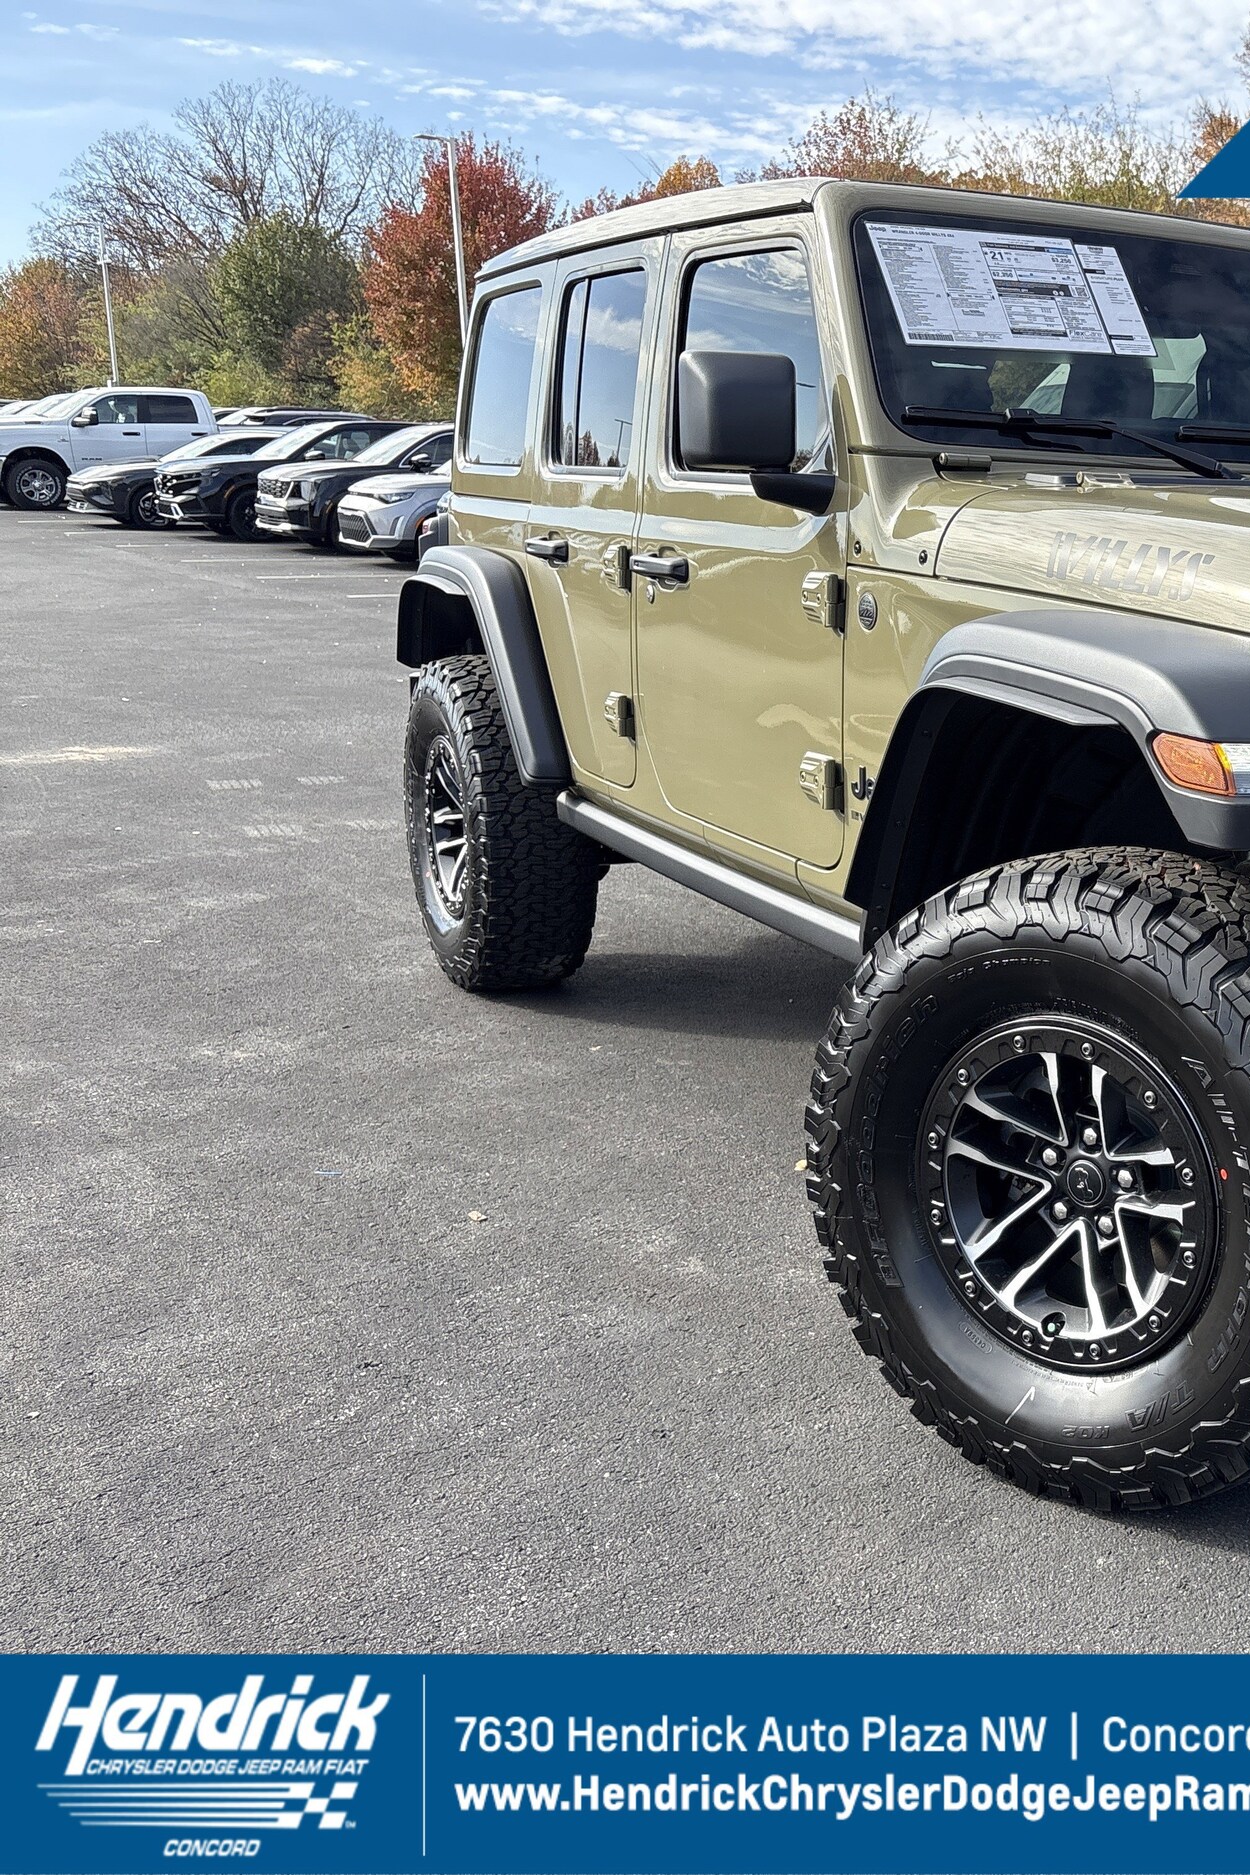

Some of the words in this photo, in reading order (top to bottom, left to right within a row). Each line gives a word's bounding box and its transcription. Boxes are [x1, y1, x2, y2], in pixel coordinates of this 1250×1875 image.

[990, 250, 1004, 260] 21
[1046, 531, 1216, 602] WILLYS
[851, 765, 875, 800] Je
[1124, 1379, 1196, 1432] T/A
